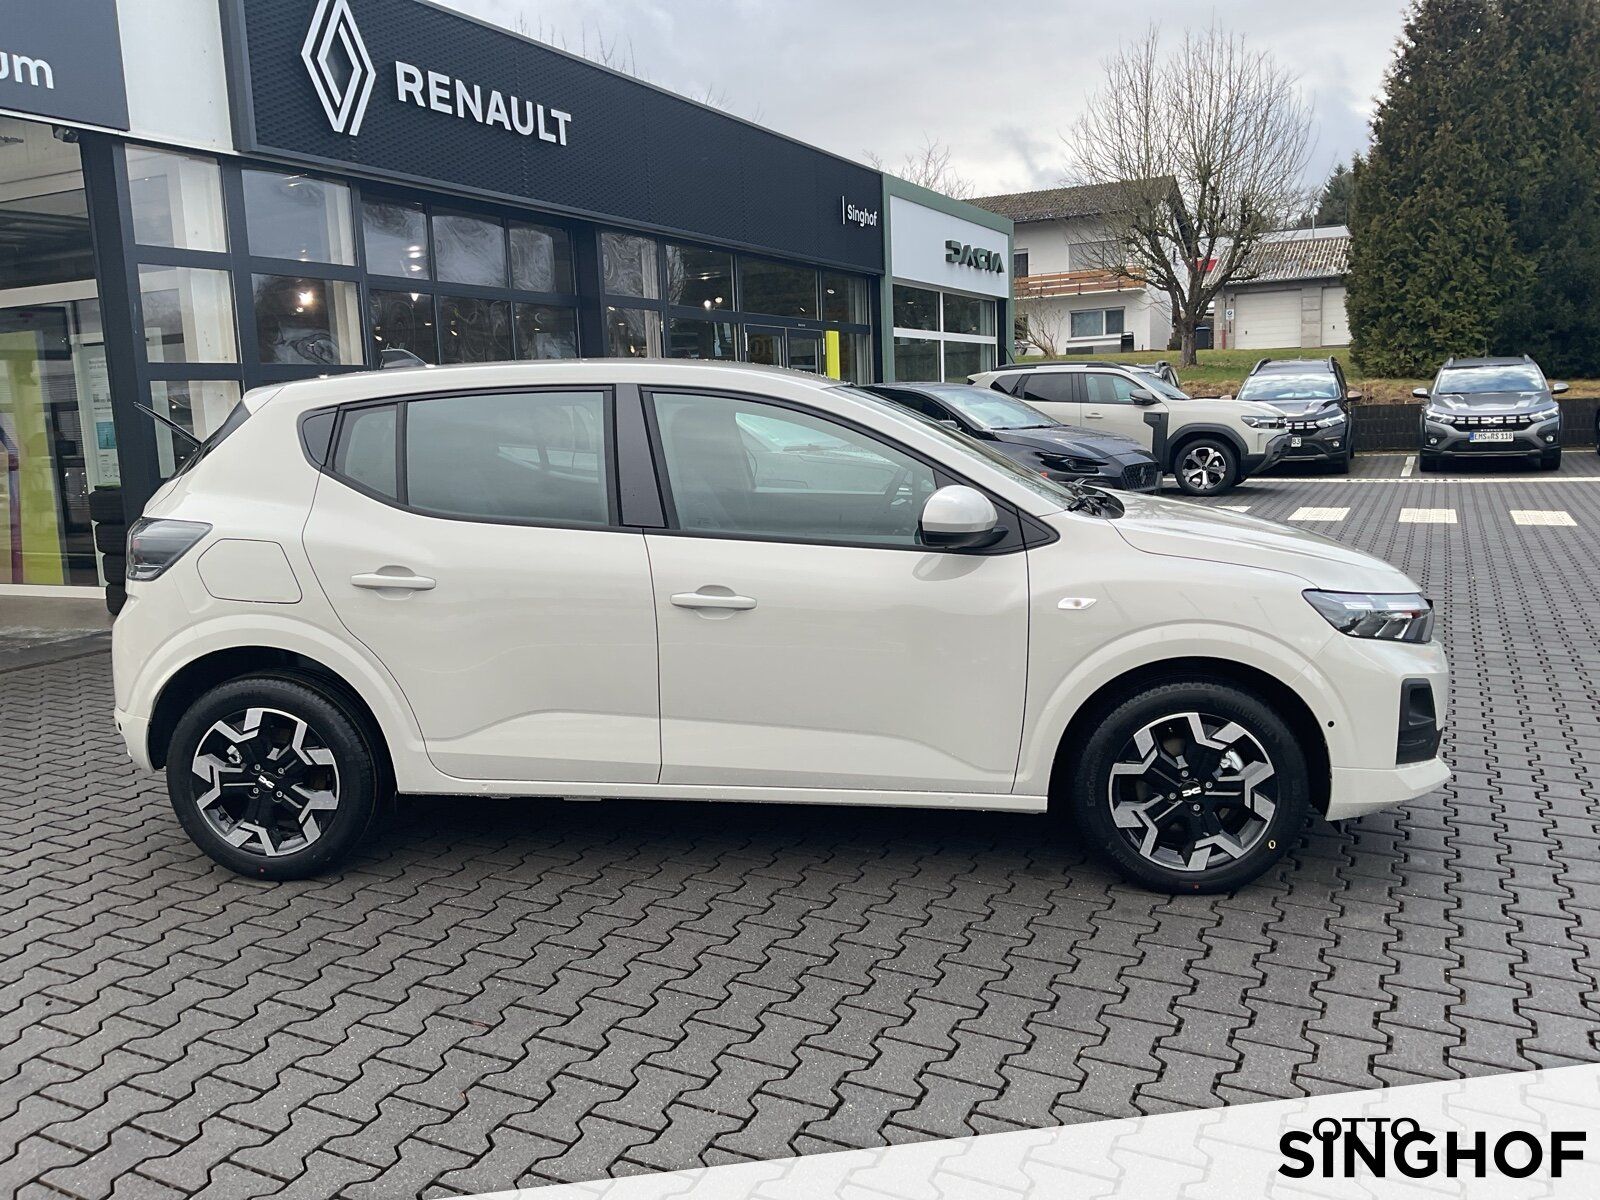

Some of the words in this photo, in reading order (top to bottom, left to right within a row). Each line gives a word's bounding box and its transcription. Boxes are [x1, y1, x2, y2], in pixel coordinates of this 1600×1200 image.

[395, 60, 572, 146] RENAULT
[847, 204, 877, 227] Singhof
[945, 240, 1004, 273] DACIA
